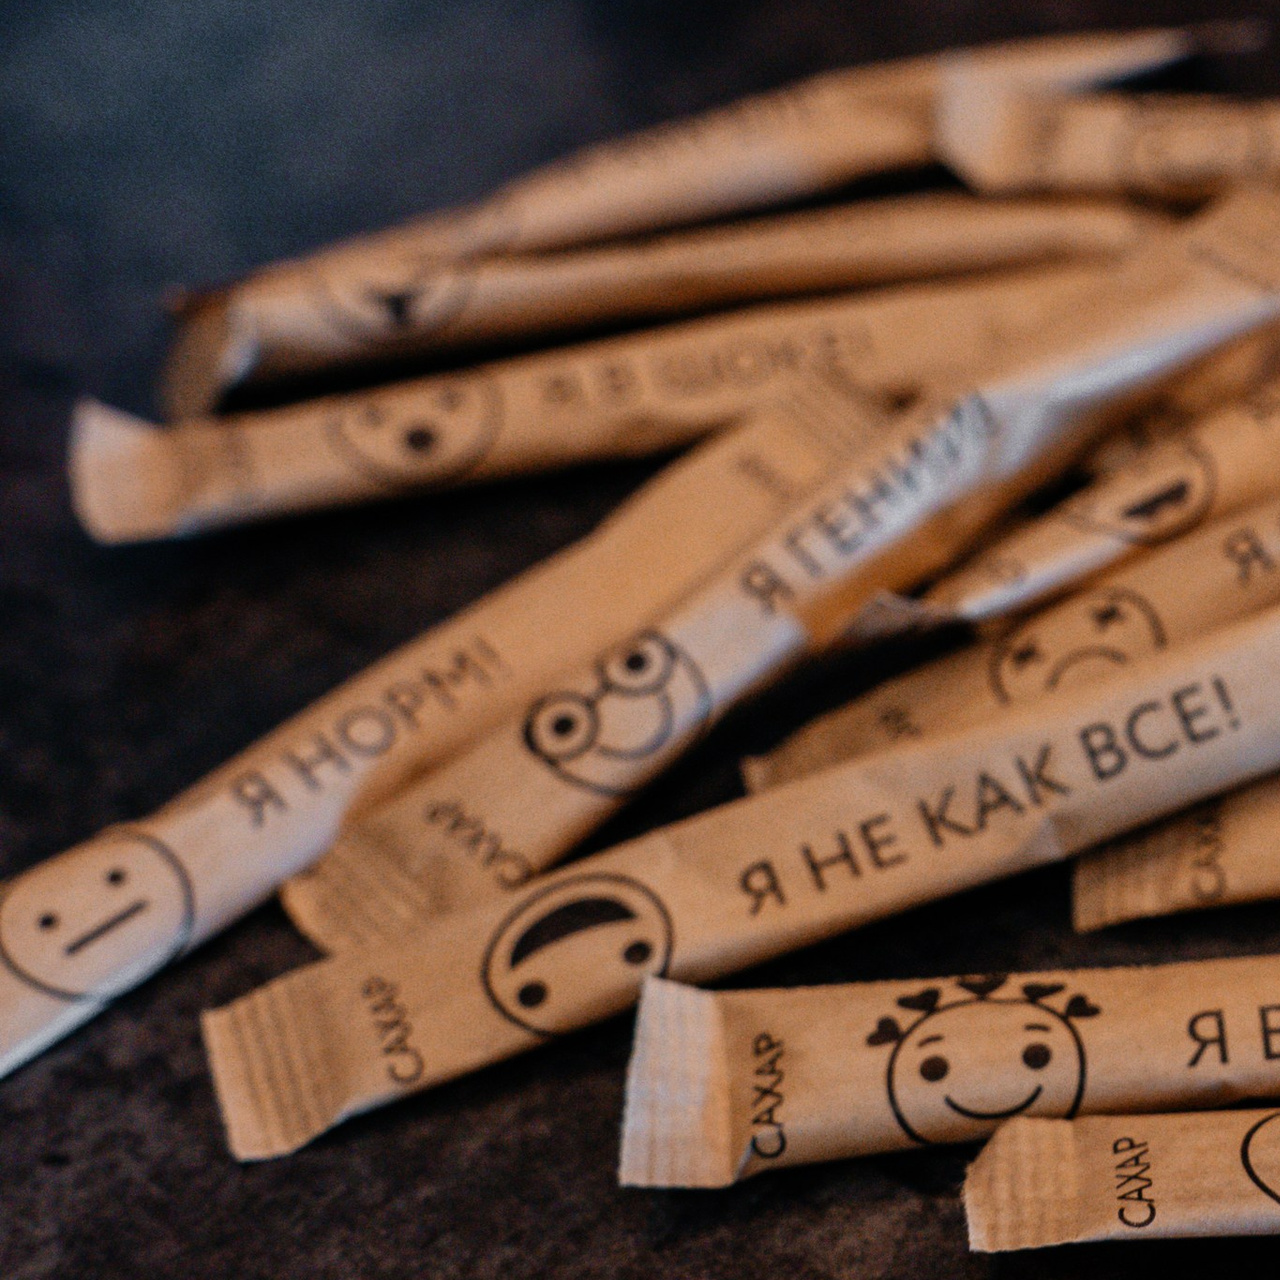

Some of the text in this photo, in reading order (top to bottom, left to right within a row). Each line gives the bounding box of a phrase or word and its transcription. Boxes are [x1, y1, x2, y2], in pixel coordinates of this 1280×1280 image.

[740, 558, 794, 618] Я
[1223, 527, 1274, 584] Я
[230, 633, 512, 829] Я НОРМ!
[738, 676, 1243, 917] Я НЕ КАК ВСЕ!
[361, 975, 425, 1083] САХАР
[1187, 1008, 1230, 1068] Я
[751, 1032, 788, 1159] САХАР
[1112, 1136, 1157, 1228] САХАР
